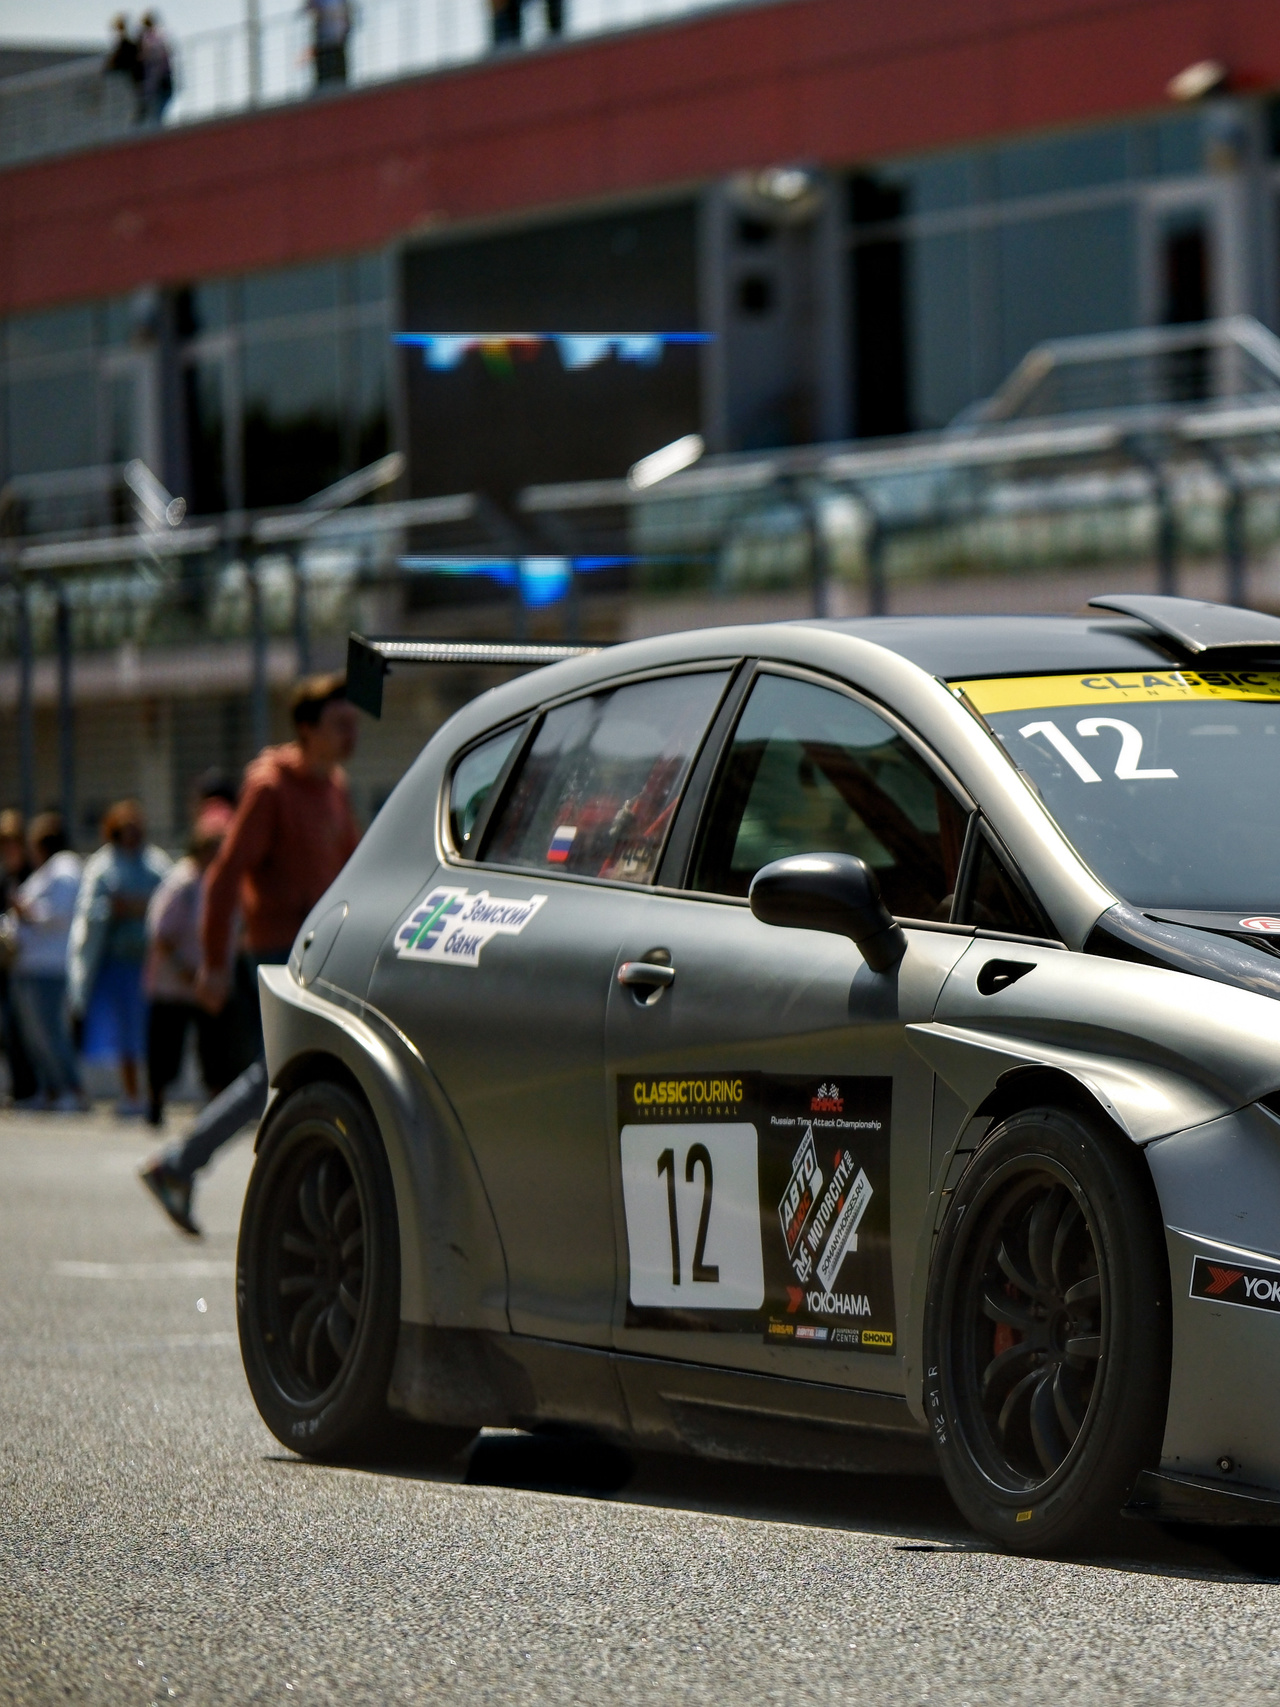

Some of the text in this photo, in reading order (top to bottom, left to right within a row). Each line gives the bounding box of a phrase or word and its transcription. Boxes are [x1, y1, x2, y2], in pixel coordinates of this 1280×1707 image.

[1081, 672, 1268, 690] CLASSIC
[1018, 716, 1179, 784] 12
[461, 897, 536, 926] Земский
[444, 927, 483, 956] банк
[638, 1106, 738, 1116] INTERNATIONAL
[770, 1116, 882, 1131] Russian Time Attack Championship
[784, 1148, 814, 1232] АВТО
[657, 1142, 719, 1286] 12
[822, 1179, 865, 1275] SOMANYHORSES.RU
[806, 1293, 871, 1316] YOKOHAMA
[836, 1334, 859, 1343] CENTER
[864, 1333, 892, 1344] SHONX
